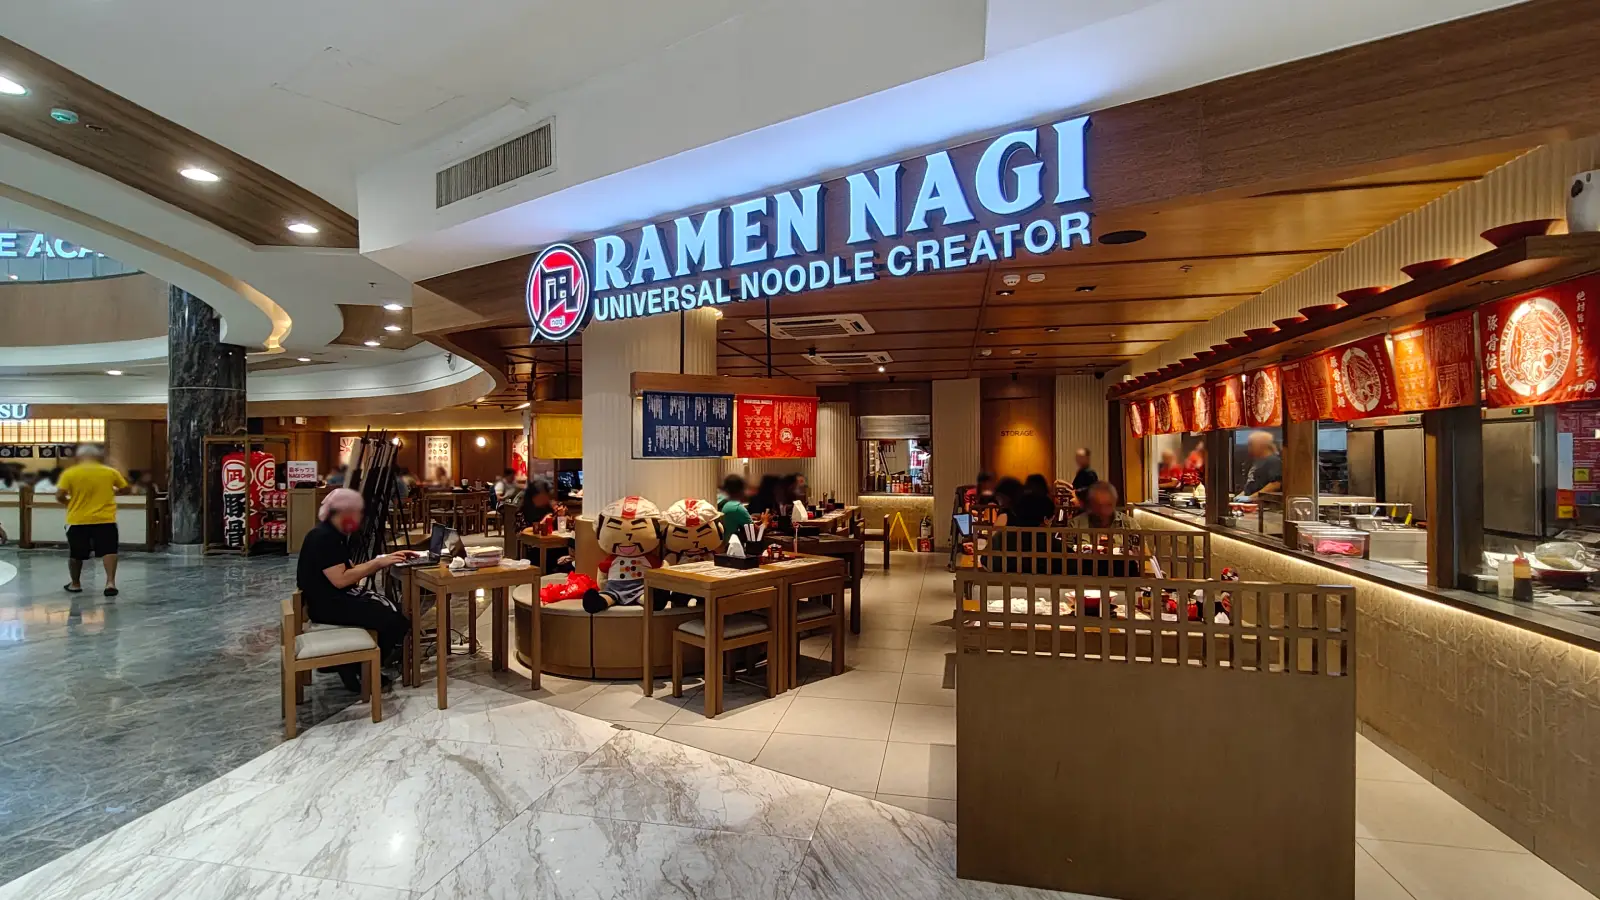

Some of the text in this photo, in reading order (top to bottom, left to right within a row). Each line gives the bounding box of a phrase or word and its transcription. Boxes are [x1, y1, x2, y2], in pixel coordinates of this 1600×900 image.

[594, 116, 1091, 291] RAMEN NAGI
[594, 211, 1091, 321] UNIVERSAL NOODLE CREATOR
